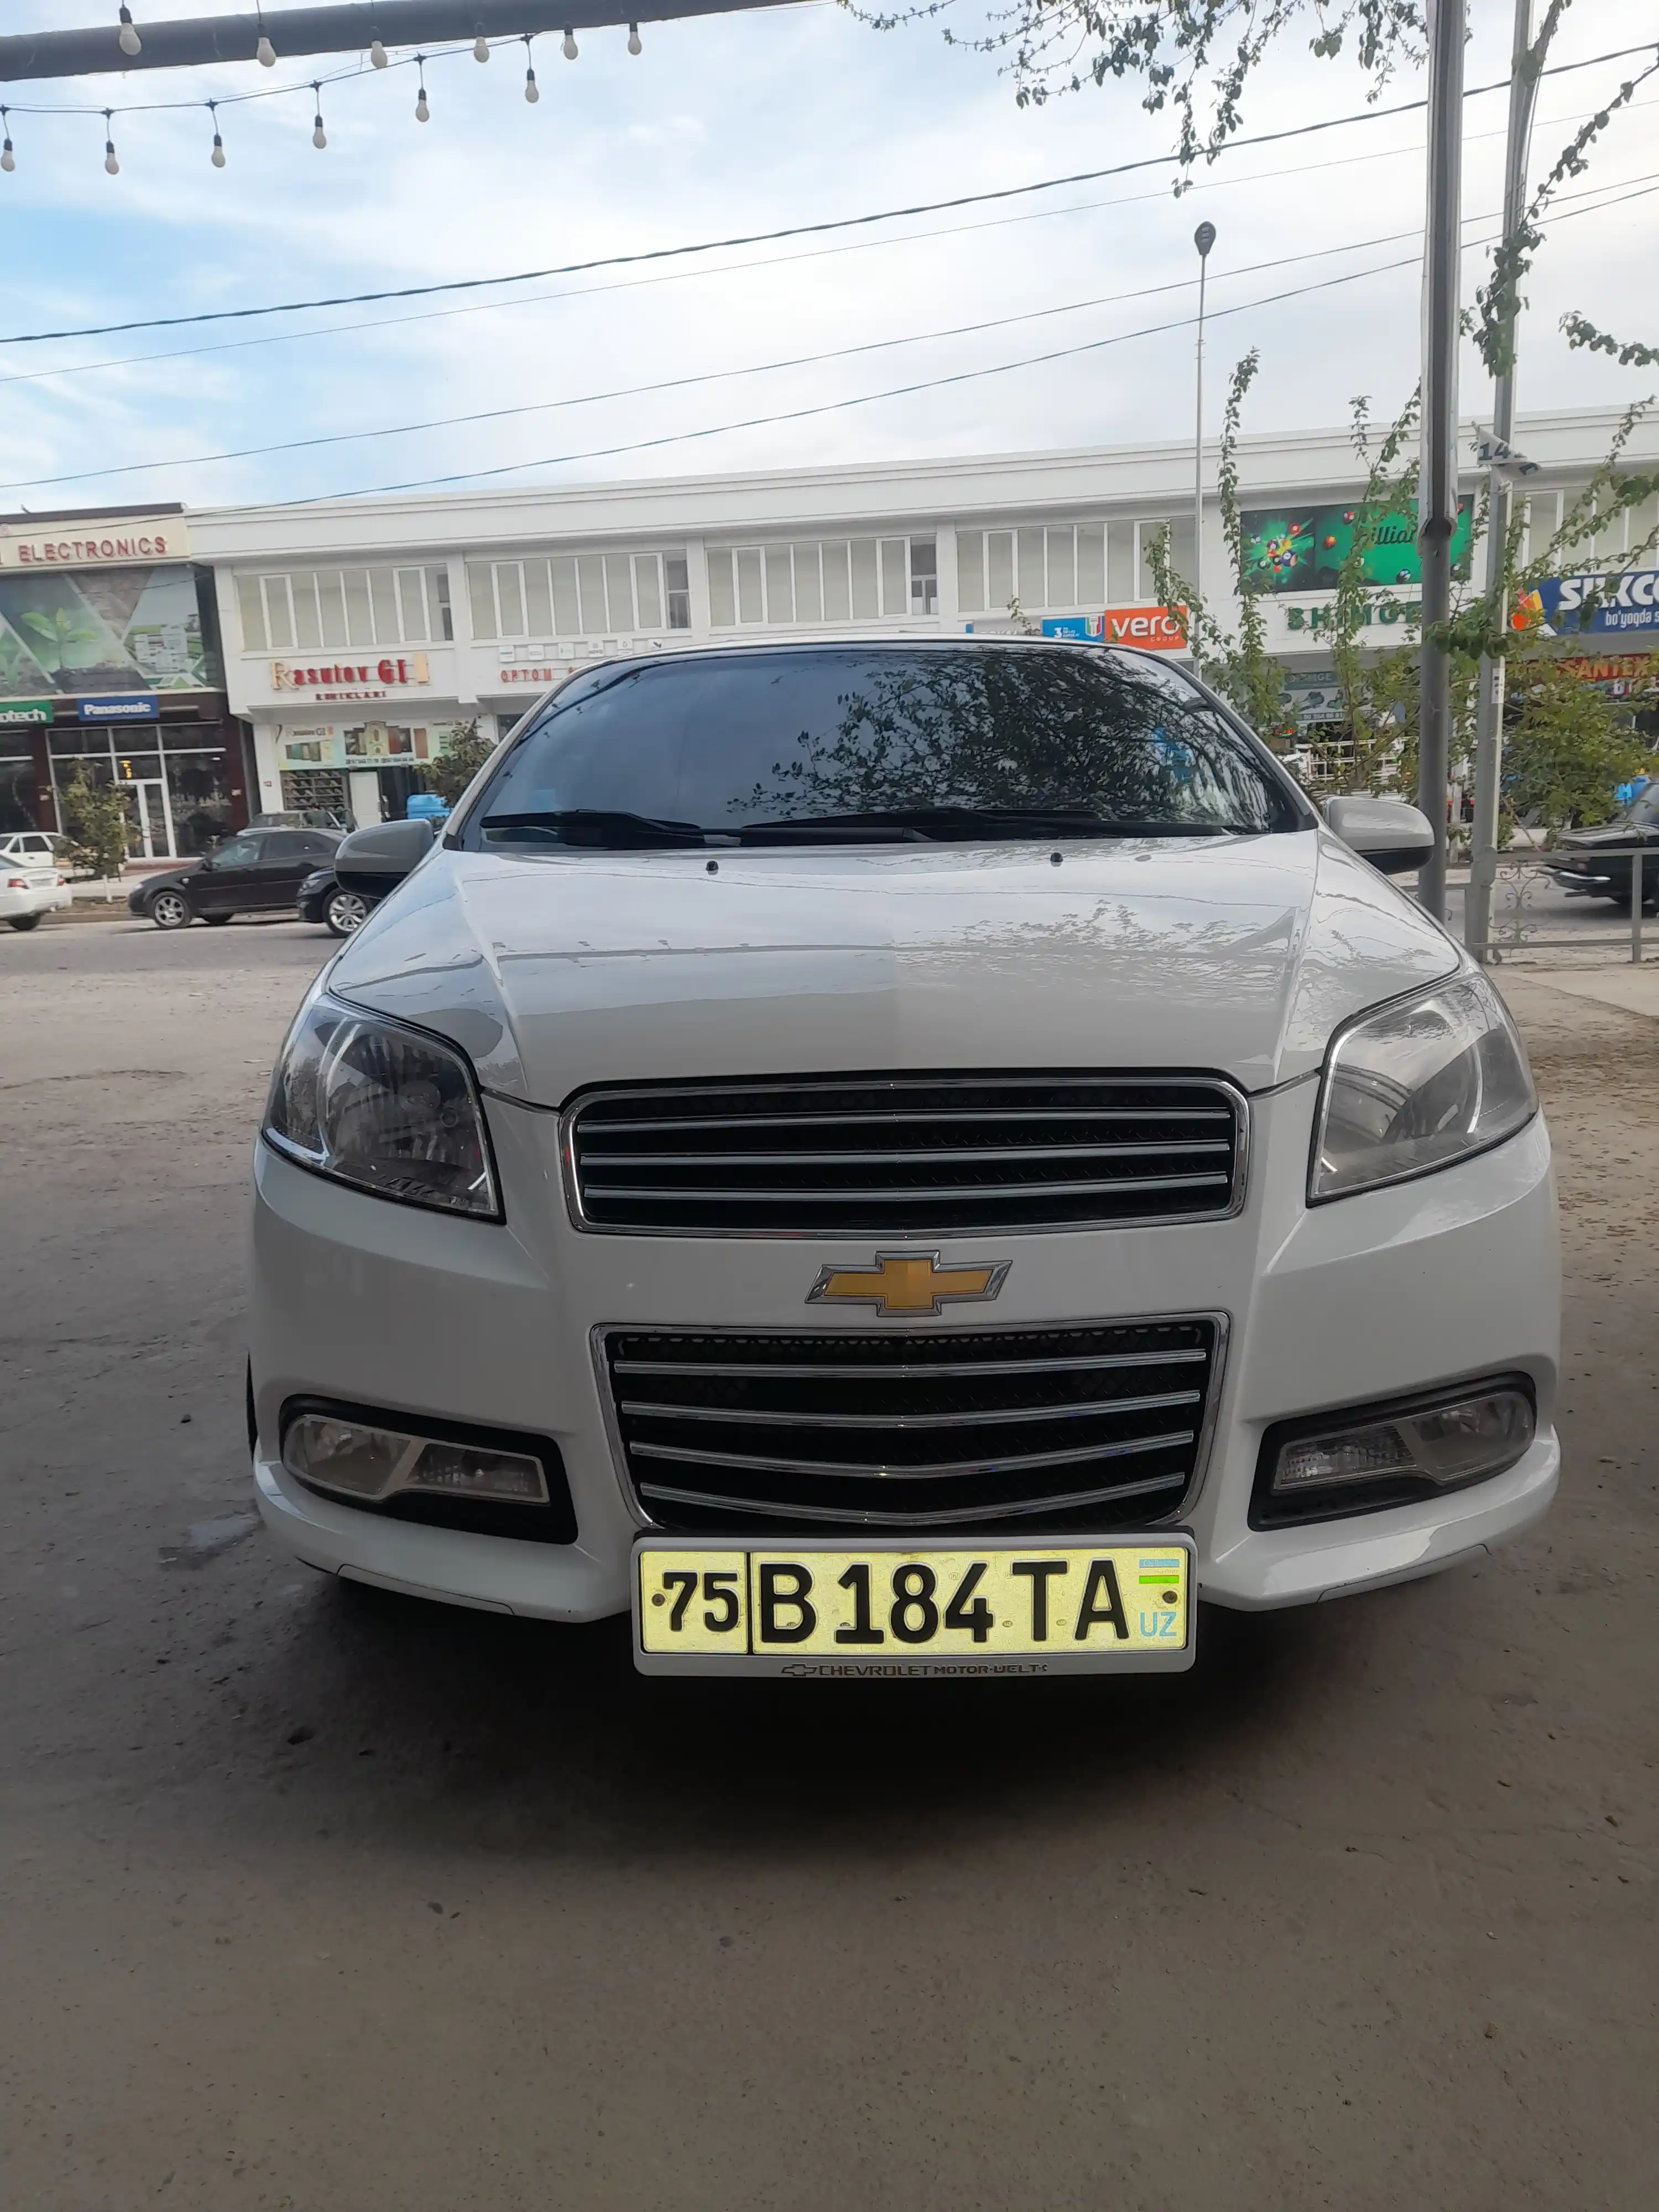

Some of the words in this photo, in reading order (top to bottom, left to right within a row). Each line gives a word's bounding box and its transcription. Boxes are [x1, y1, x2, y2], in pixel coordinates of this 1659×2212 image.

[18, 536, 168, 562] ELECTRONICS
[1558, 574, 1659, 611] SILKC
[1111, 615, 1180, 637] vero
[84, 702, 152, 716] Panasonic
[663, 1571, 740, 1632] 75
[1140, 1611, 1177, 1637] UZ
[819, 1665, 932, 1676] CHEVROLET
